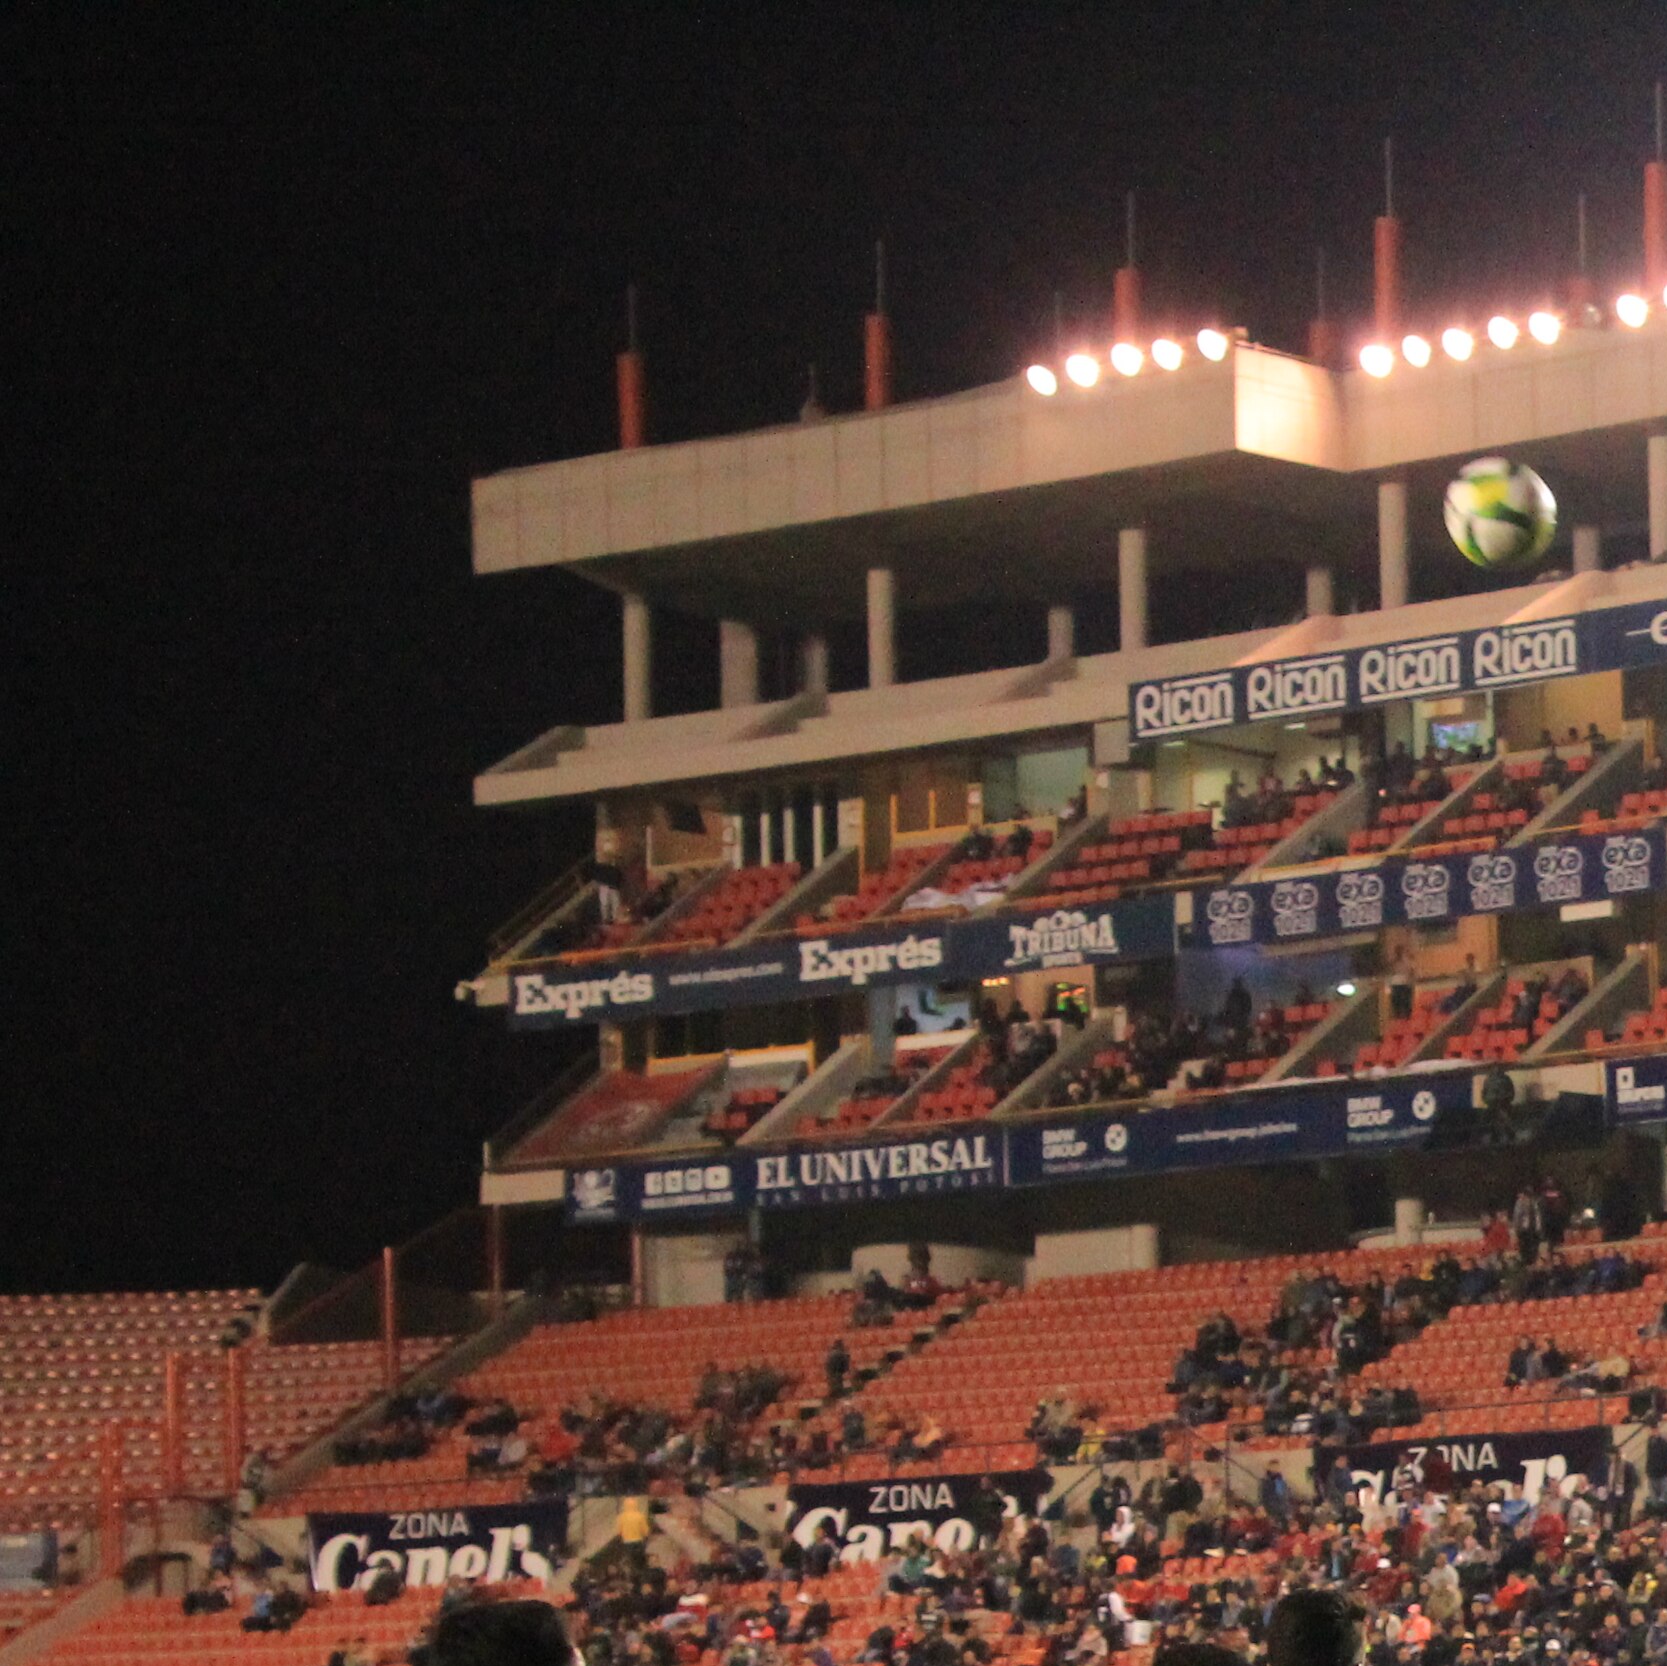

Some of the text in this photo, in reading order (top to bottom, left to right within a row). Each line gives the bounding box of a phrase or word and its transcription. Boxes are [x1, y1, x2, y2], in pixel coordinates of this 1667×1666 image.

[1136, 626, 1577, 731] Ricon Ricon Ricon Ricon
[799, 934, 943, 985] Exprés
[1010, 913, 1115, 958] TRIBUNA
[514, 970, 653, 1020] Exprés
[757, 1135, 991, 1190] EL UNIVERSAL
[867, 1483, 955, 1514] ZONA
[388, 1512, 470, 1540] ZONA
